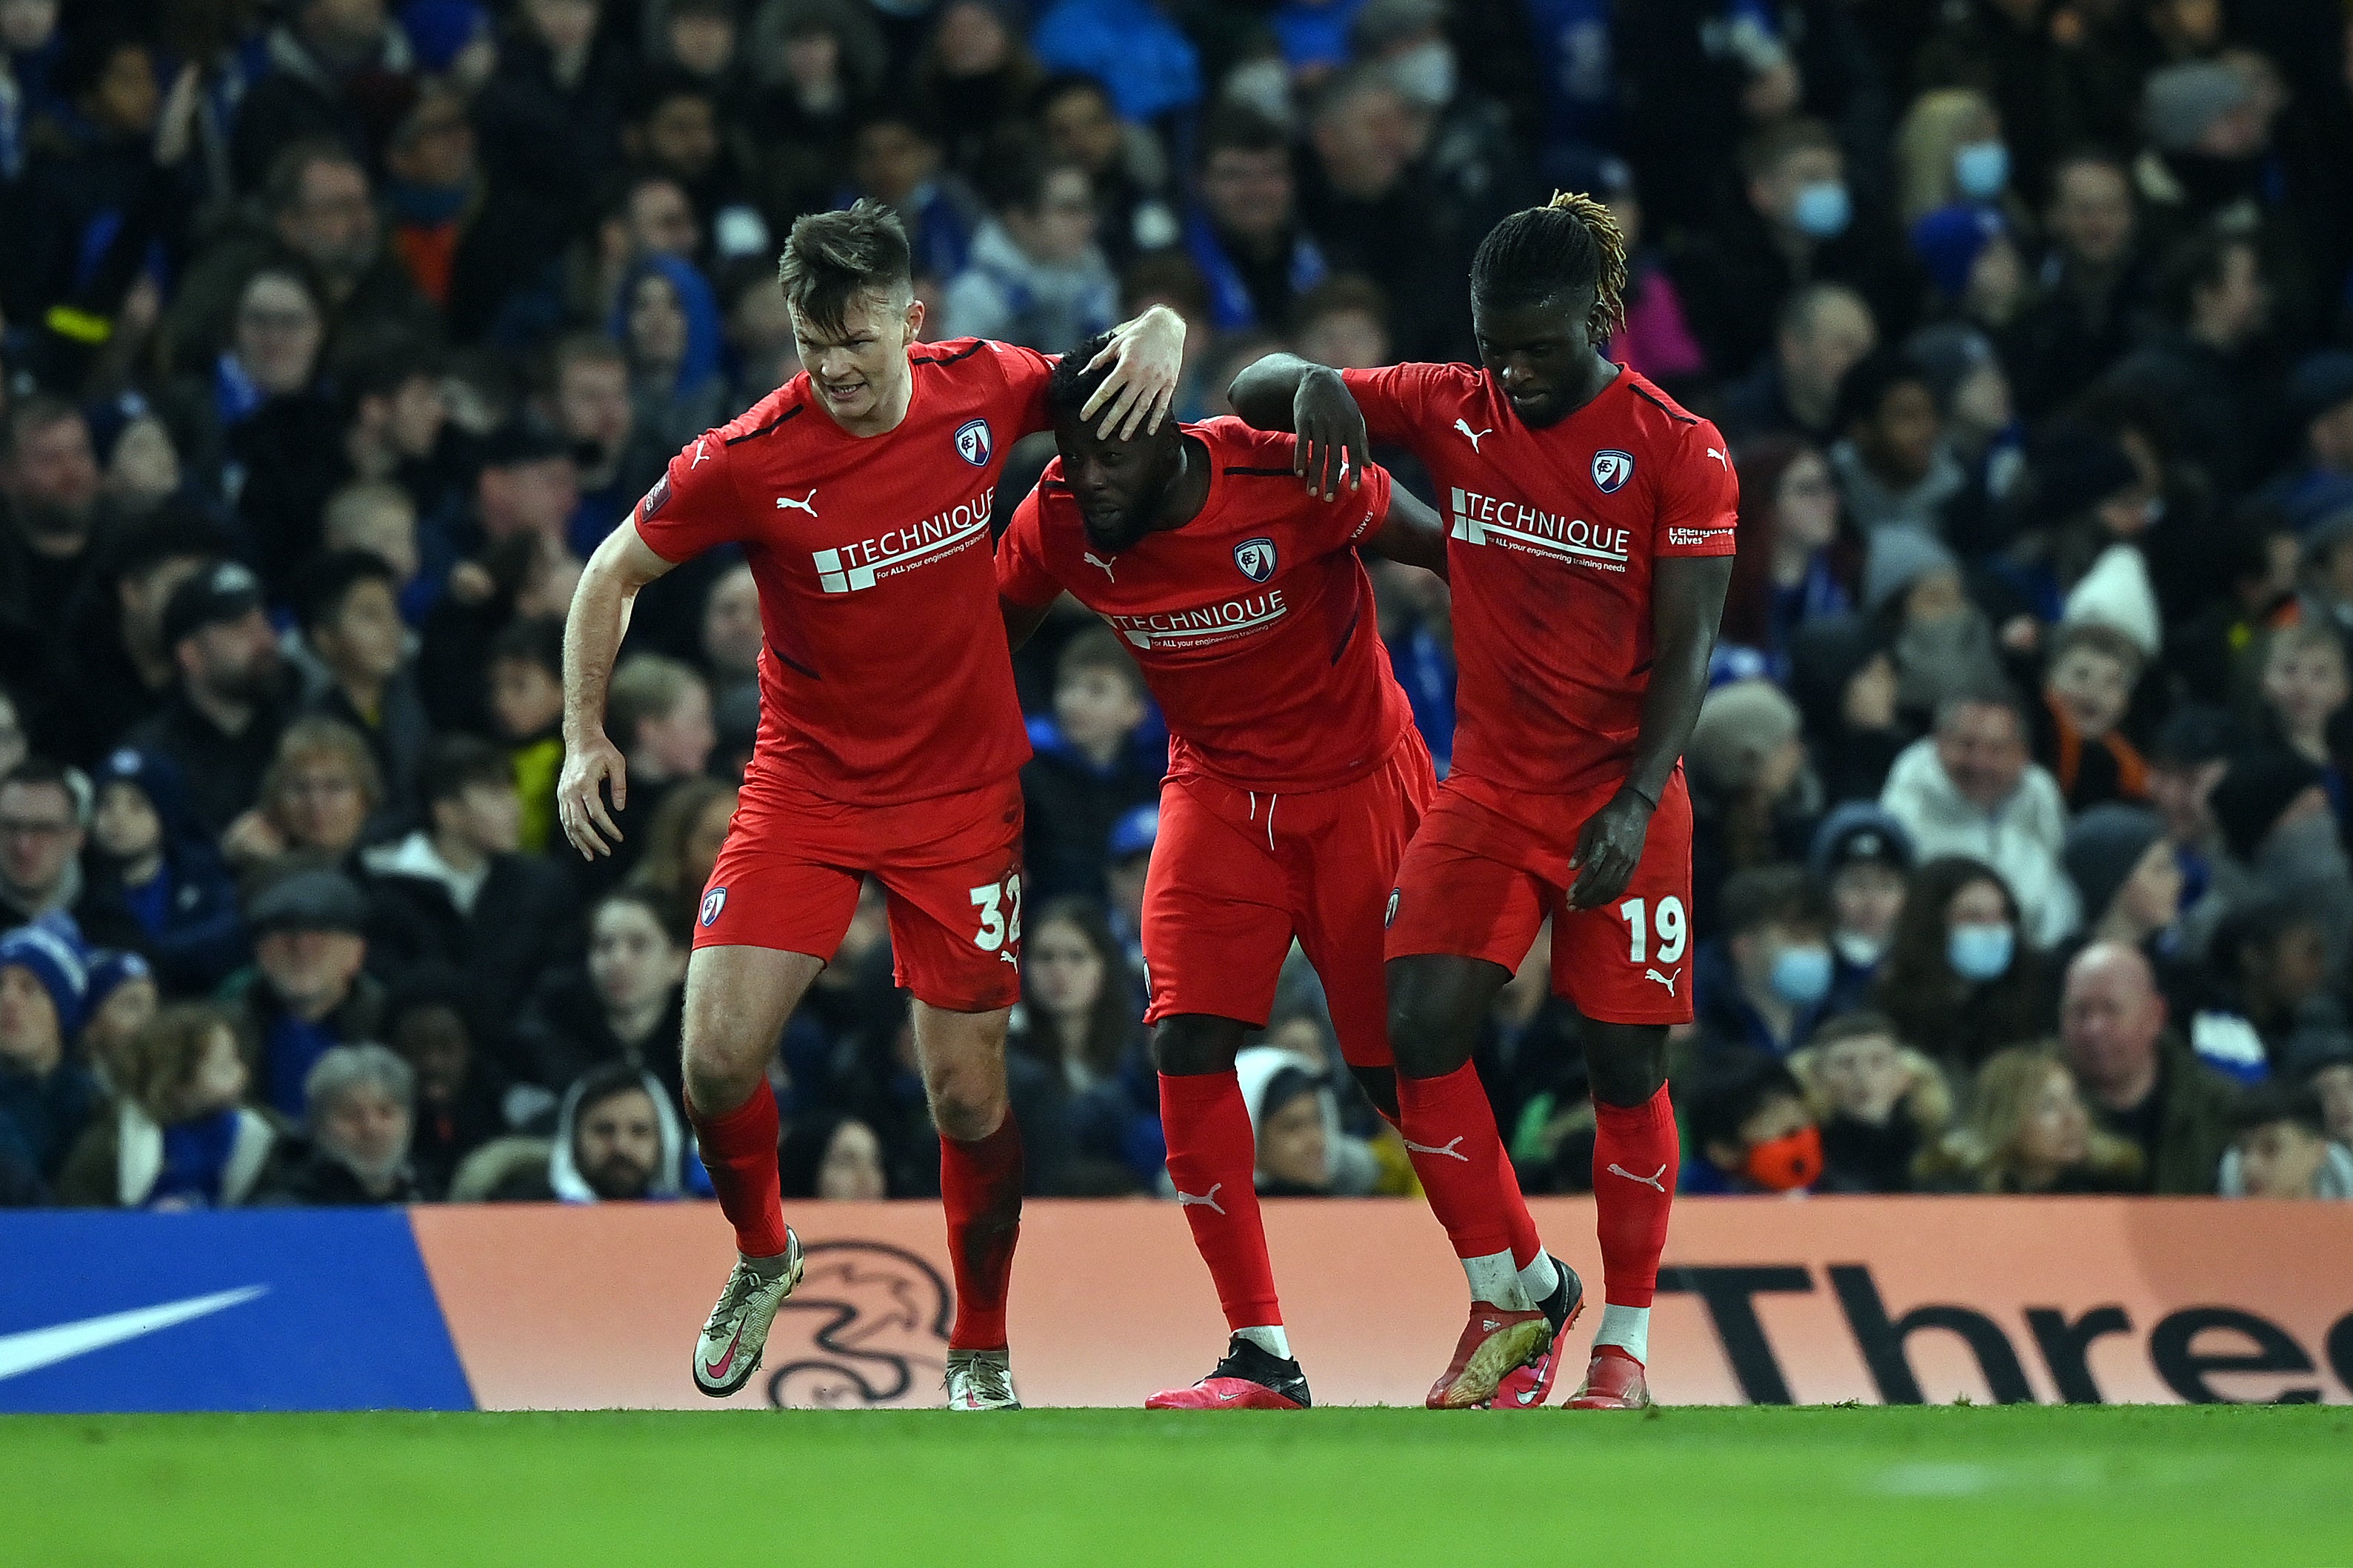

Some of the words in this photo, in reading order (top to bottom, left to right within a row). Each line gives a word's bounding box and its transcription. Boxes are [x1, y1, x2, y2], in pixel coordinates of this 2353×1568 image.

[841, 486, 994, 567] TECHNIQUE
[1350, 510, 1374, 538] Valves
[1467, 493, 1629, 553] TECHNIQUE
[1669, 535, 1703, 545] Valves
[877, 571, 890, 579] For
[891, 565, 906, 576] ALL
[907, 560, 923, 572] your
[924, 544, 964, 564] engineering
[1495, 538, 1508, 547] ALL
[1508, 542, 1526, 551] your
[1526, 547, 1572, 564] engineering
[1573, 558, 1602, 570] training
[1603, 564, 1626, 573] needs
[1112, 590, 1285, 630] TECHNIQUE
[1178, 640, 1193, 649] your
[1195, 633, 1239, 646] engineering
[1240, 625, 1269, 638] training
[969, 874, 1021, 952] 32
[1620, 895, 1687, 964] 19
[1655, 1265, 2353, 1403] Thre
